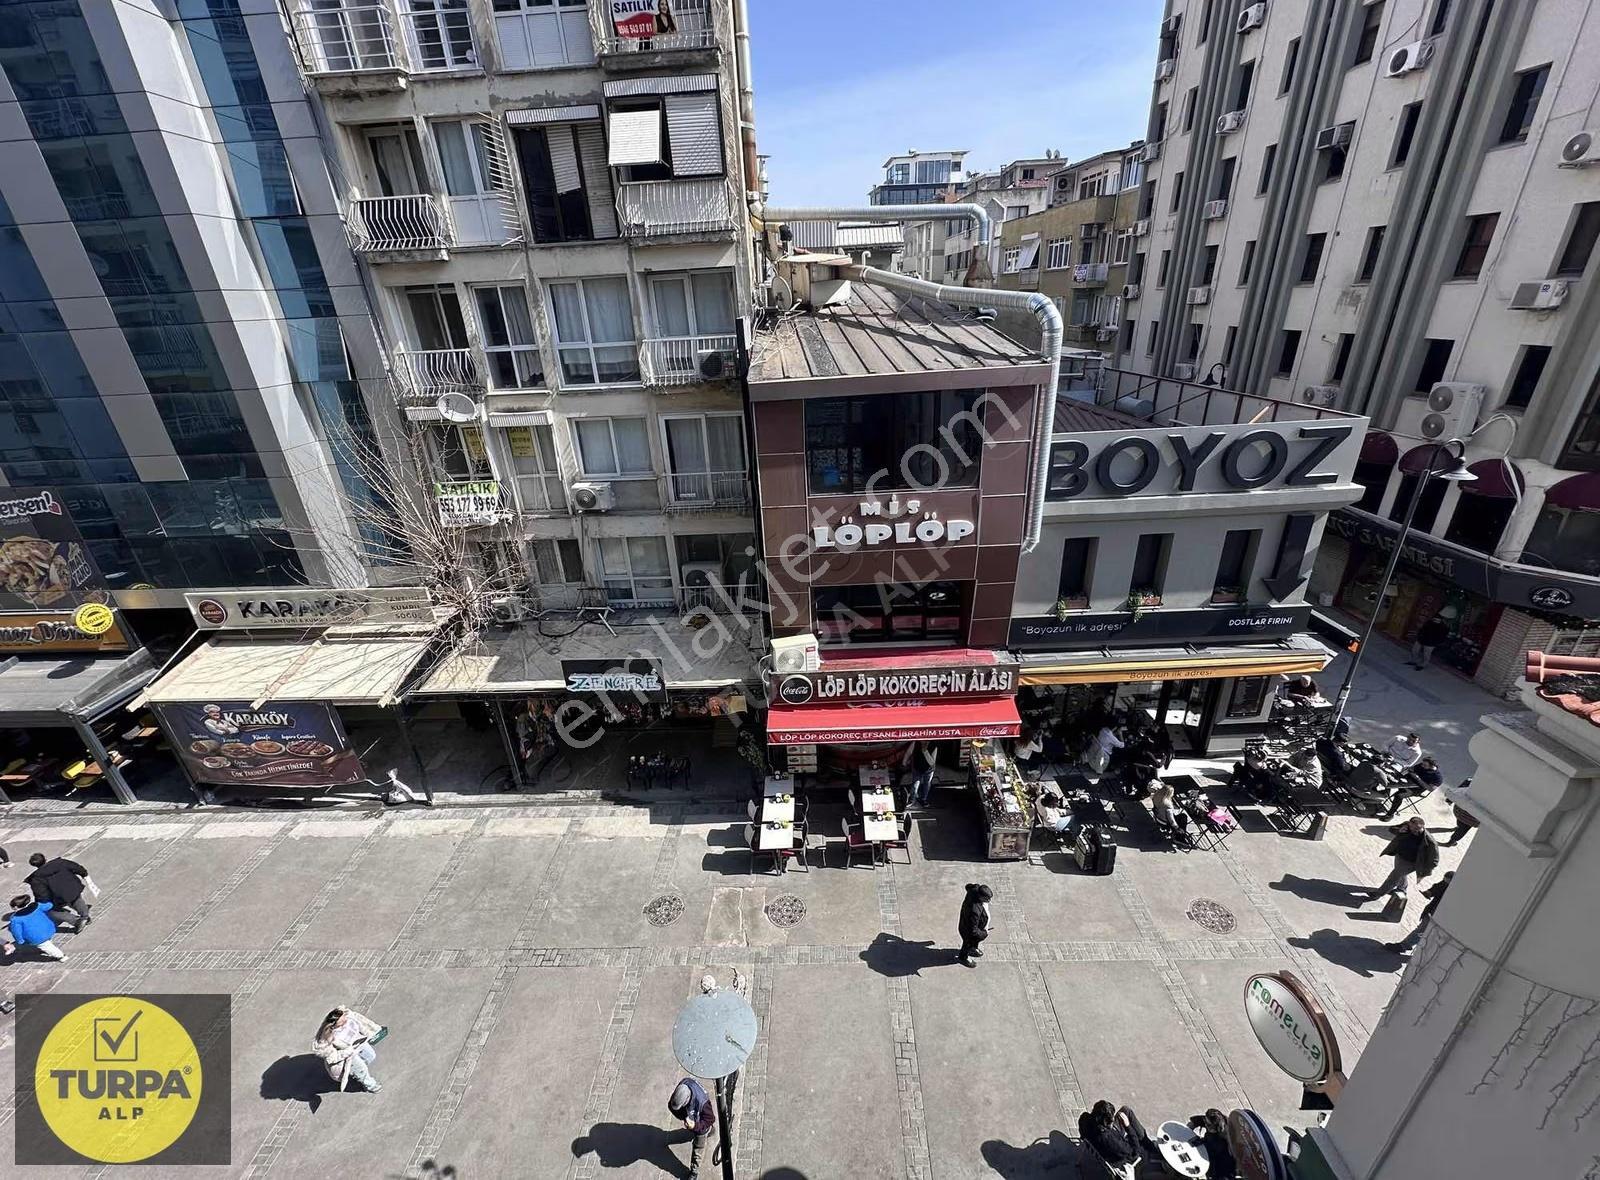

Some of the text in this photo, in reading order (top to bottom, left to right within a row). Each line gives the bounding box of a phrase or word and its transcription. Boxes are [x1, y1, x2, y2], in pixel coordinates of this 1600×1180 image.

[613, 0, 655, 13] SATILIK
[1048, 426, 1353, 498] BOYOZ
[860, 494, 921, 516] MİS
[813, 511, 975, 548] LÖPLÖP
[1075, 623, 1087, 632] ilk
[1228, 618, 1267, 626] DOSTLAR
[817, 674, 846, 698] LÖP
[848, 673, 877, 697] LÖP
[223, 711, 289, 727] KARAKÖY
[818, 732, 860, 740] KOKOREÇ
[938, 728, 962, 736] USTA
[1252, 979, 1321, 1060] romella
